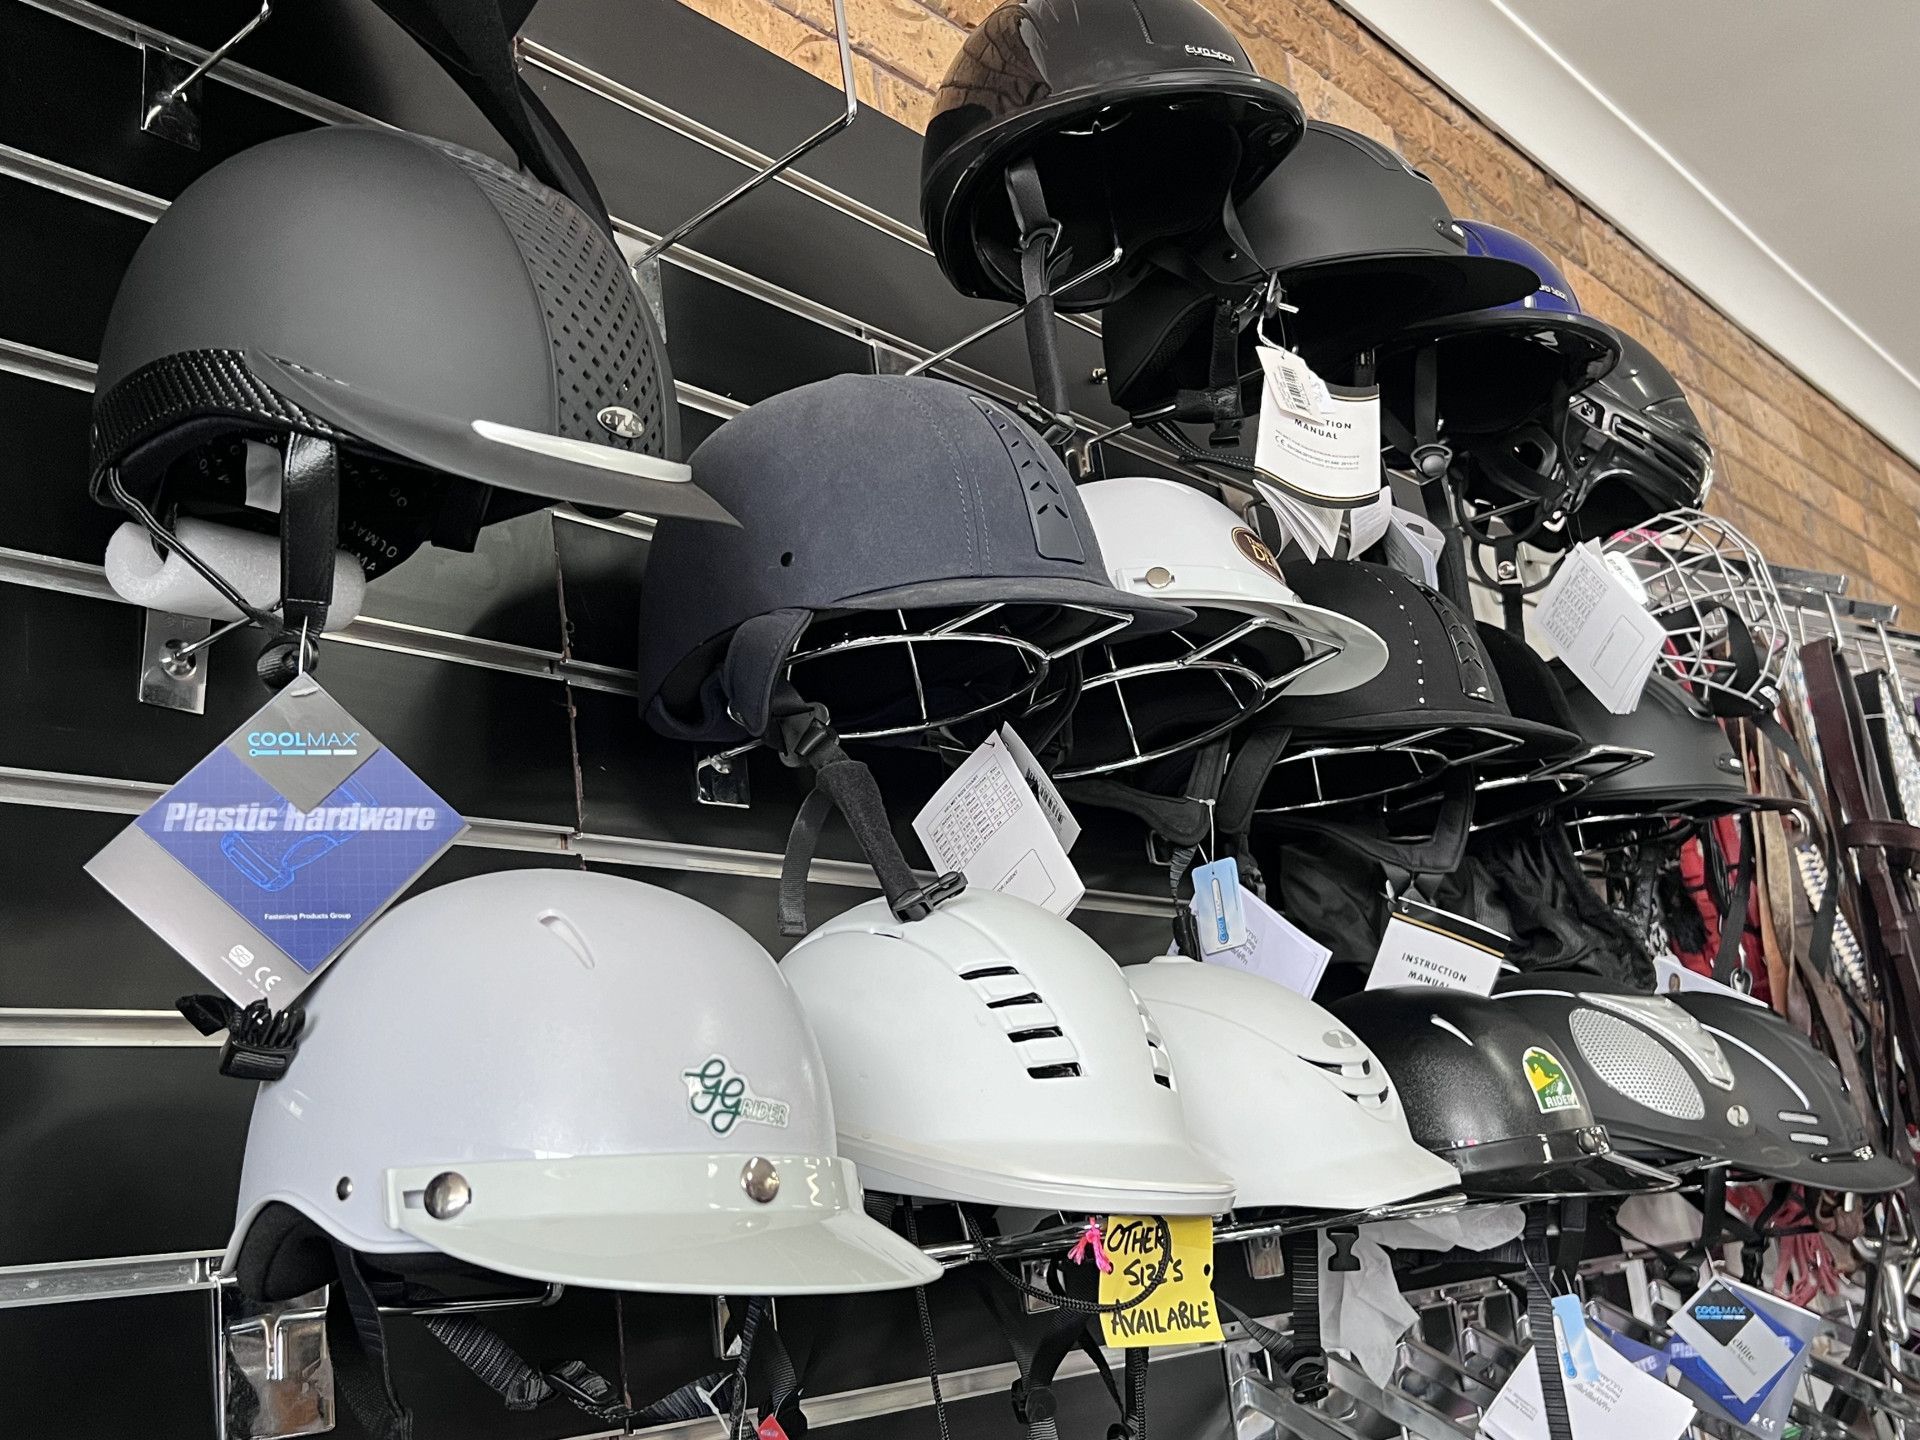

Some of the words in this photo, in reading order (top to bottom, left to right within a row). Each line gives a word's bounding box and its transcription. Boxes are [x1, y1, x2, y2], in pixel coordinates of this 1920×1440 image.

[1294, 418, 1338, 440] MANUAL
[1325, 419, 1352, 430] TION
[248, 731, 358, 747] COOLMAX
[163, 802, 279, 832] Plastic
[264, 913, 298, 921] Fastening
[299, 912, 329, 920] Products
[329, 912, 352, 920] Group
[1401, 952, 1467, 983] INSTRUCTION
[1407, 970, 1450, 989] MANUA
[1111, 1298, 1211, 1338] AVAILABLE
